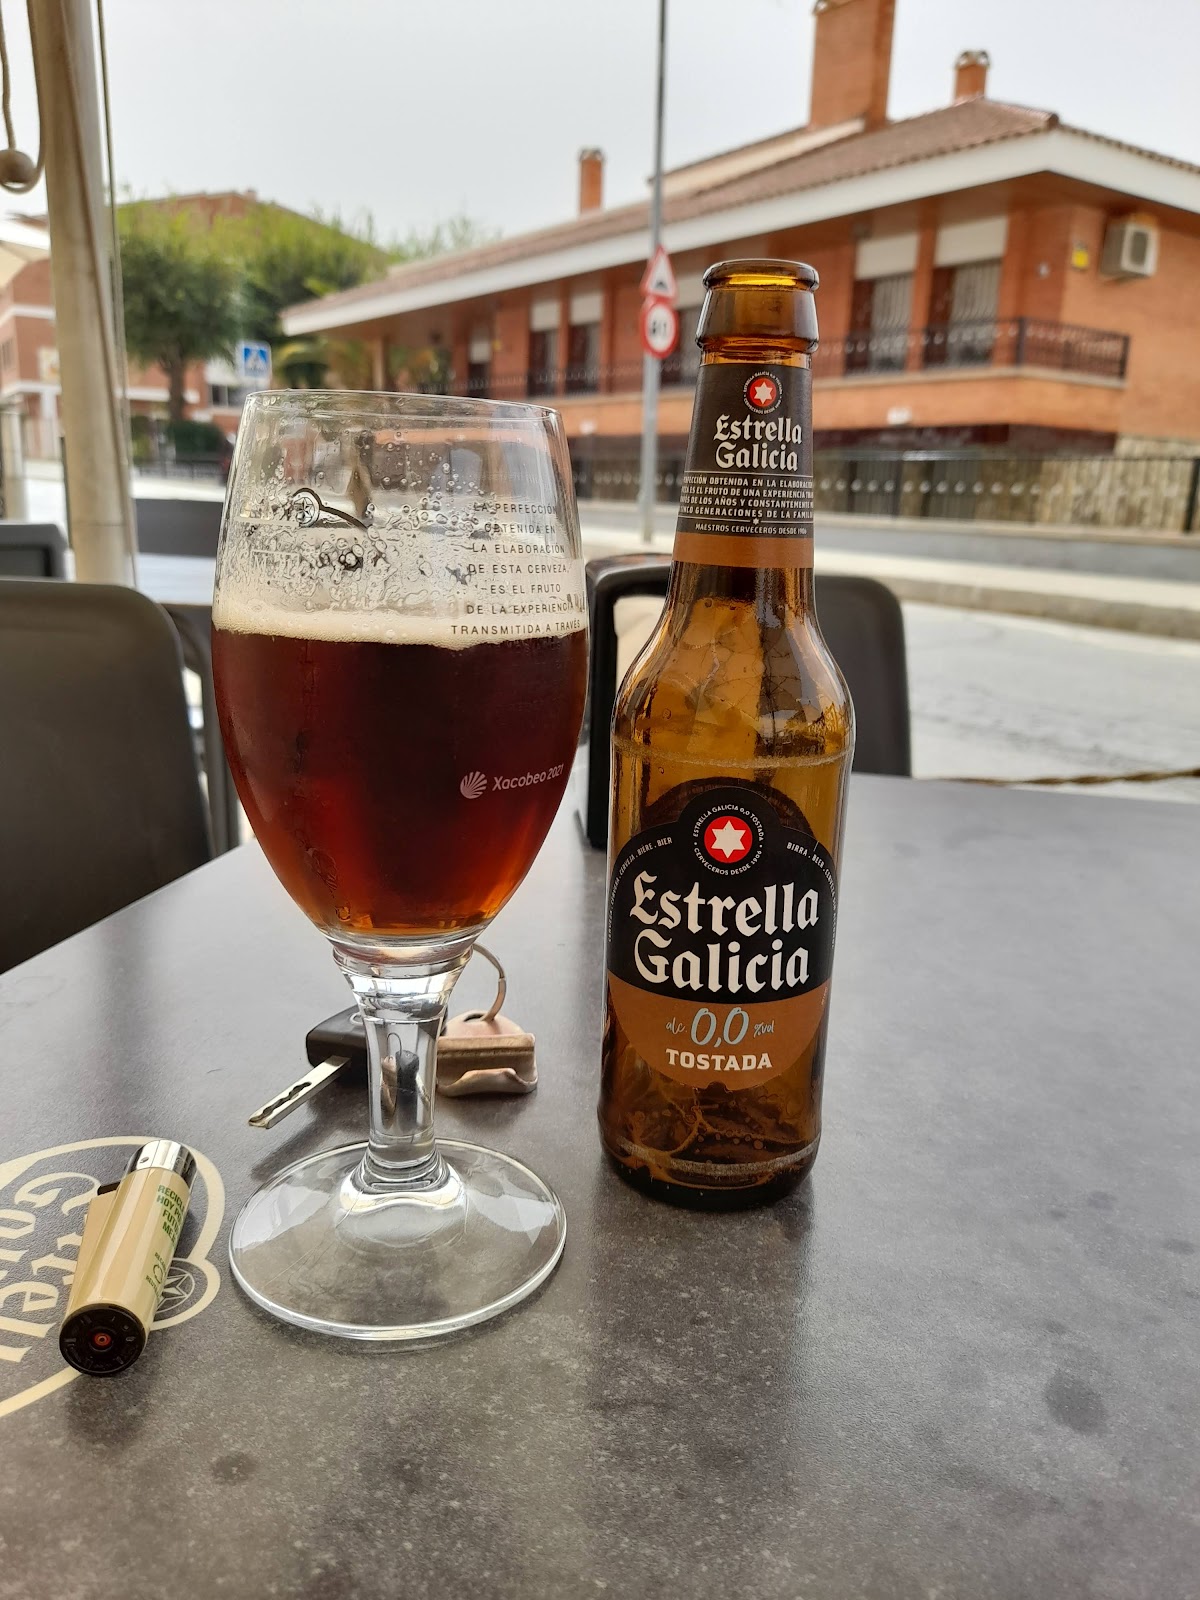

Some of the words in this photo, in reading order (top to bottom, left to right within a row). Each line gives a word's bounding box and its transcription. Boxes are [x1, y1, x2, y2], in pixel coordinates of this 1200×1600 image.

[713, 414, 802, 444] Estrella
[715, 441, 798, 471] Galicia
[709, 477, 749, 486] OBTENIDA
[752, 479, 763, 487] EN
[766, 480, 777, 488] LA
[696, 486, 703, 495] EL
[704, 487, 729, 496] FRUTO
[730, 488, 741, 496] DE
[743, 489, 761, 497] UNA
[763, 490, 806, 498] EXPERIENCIA
[473, 502, 489, 512] LA
[699, 497, 713, 505] LOS
[714, 495, 738, 506] AÑOS
[740, 499, 746, 507] Y
[695, 506, 763, 518] GENERACIONES
[766, 510, 778, 518] DE
[780, 511, 791, 519] LA
[484, 522, 542, 535] OBTENIDA
[545, 525, 556, 535] EN
[695, 523, 730, 532] MAESTROS
[731, 525, 777, 535] CERVECEROS
[778, 527, 798, 535] DESDE
[472, 543, 488, 553] LA
[494, 543, 565, 554] ELABORACIÓN
[468, 564, 486, 574] DE
[492, 564, 522, 574] ESTA
[490, 584, 506, 594] ES
[512, 585, 525, 594] EL
[531, 583, 561, 594] FRUTO
[466, 604, 484, 614] DE
[491, 605, 507, 614] LA
[513, 601, 574, 614] EXPERIENCIA
[451, 624, 541, 635] TRANSMITIDA
[545, 623, 552, 633] A
[555, 617, 581, 631] TRAVÉS
[492, 771, 546, 791] Xacobeo
[546, 764, 564, 780] 2021
[692, 811, 712, 838] ESTRELLA
[712, 804, 739, 813] GALICIA
[739, 807, 750, 816] 0,0
[749, 813, 764, 842] TOSTADA
[637, 843, 653, 856] BIÈRE
[656, 837, 673, 847] BIER
[694, 847, 729, 875] CERVECEROS
[730, 863, 751, 875] DESDE
[751, 850, 762, 865] 1906
[786, 842, 808, 857] BIRRA
[811, 853, 825, 869] BEER
[629, 870, 819, 936] Estrella
[634, 928, 810, 993] Galicia
[665, 1017, 688, 1035] alc.
[690, 1007, 750, 1048] 0,0
[665, 1048, 773, 1071] TOSTADA
[156, 1195, 175, 1211] HOY
